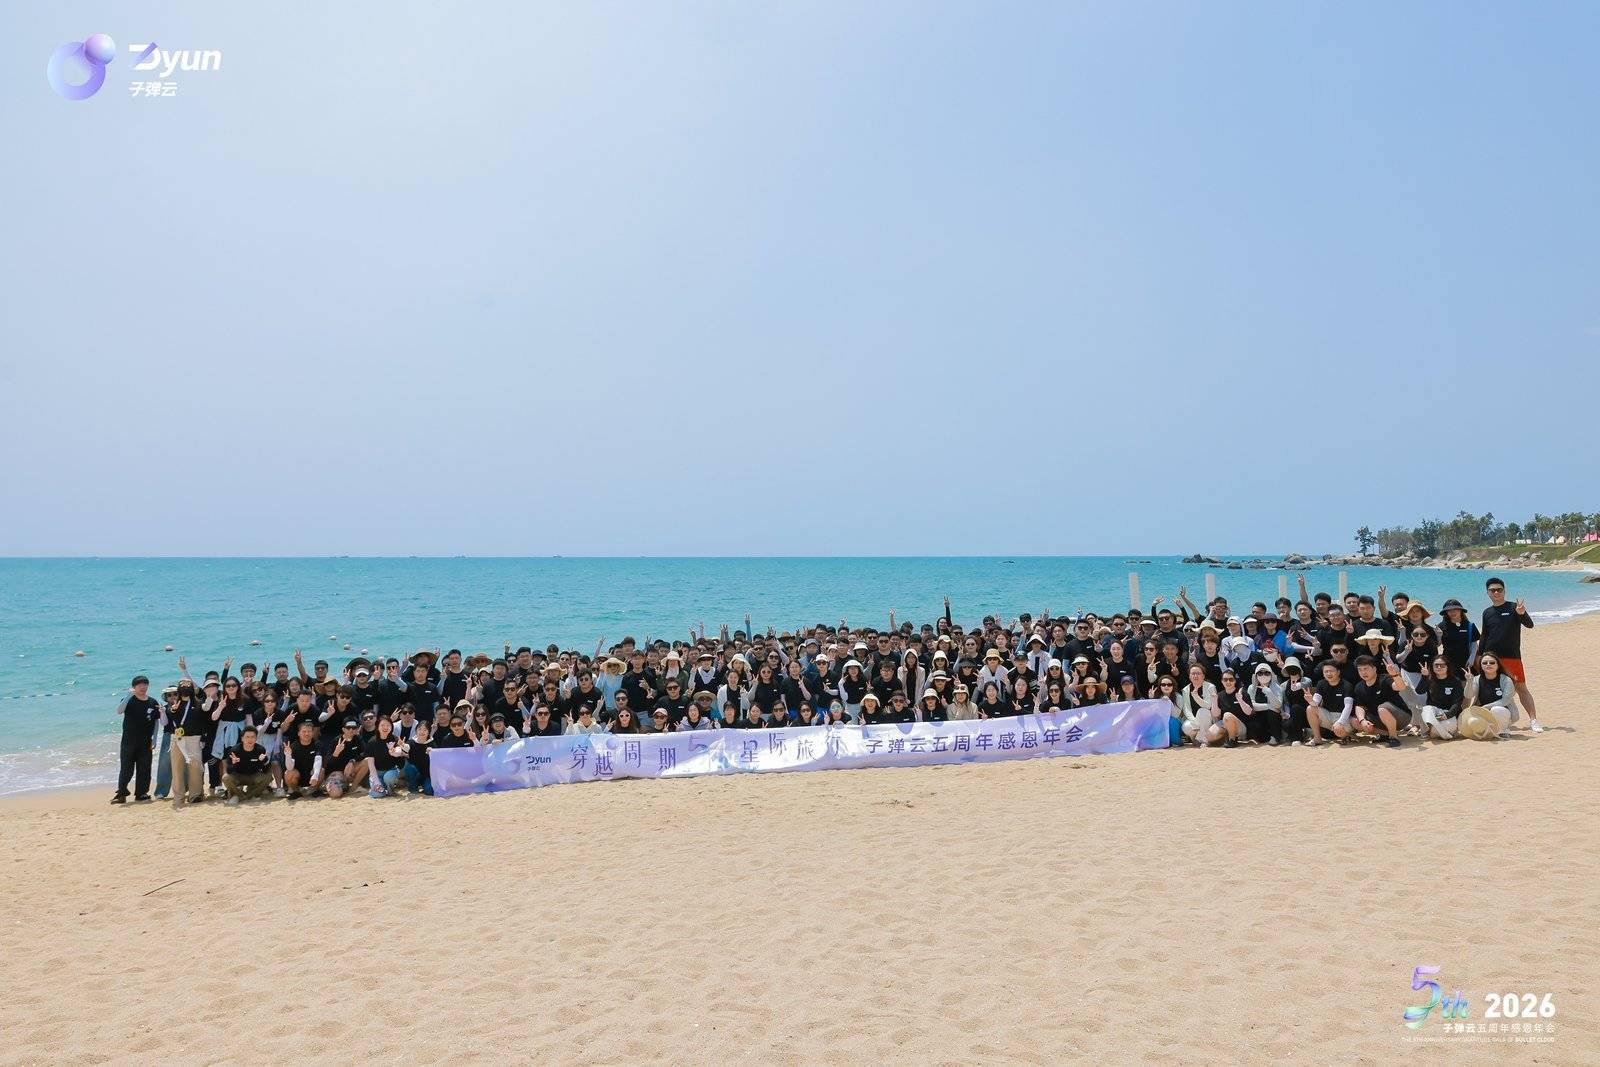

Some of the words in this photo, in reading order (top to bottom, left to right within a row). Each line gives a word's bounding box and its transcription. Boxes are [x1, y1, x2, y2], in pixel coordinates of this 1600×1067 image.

[865, 725, 1084, 754] 子弹云五周年感恩年会
[568, 740, 676, 776] 穿越周期
